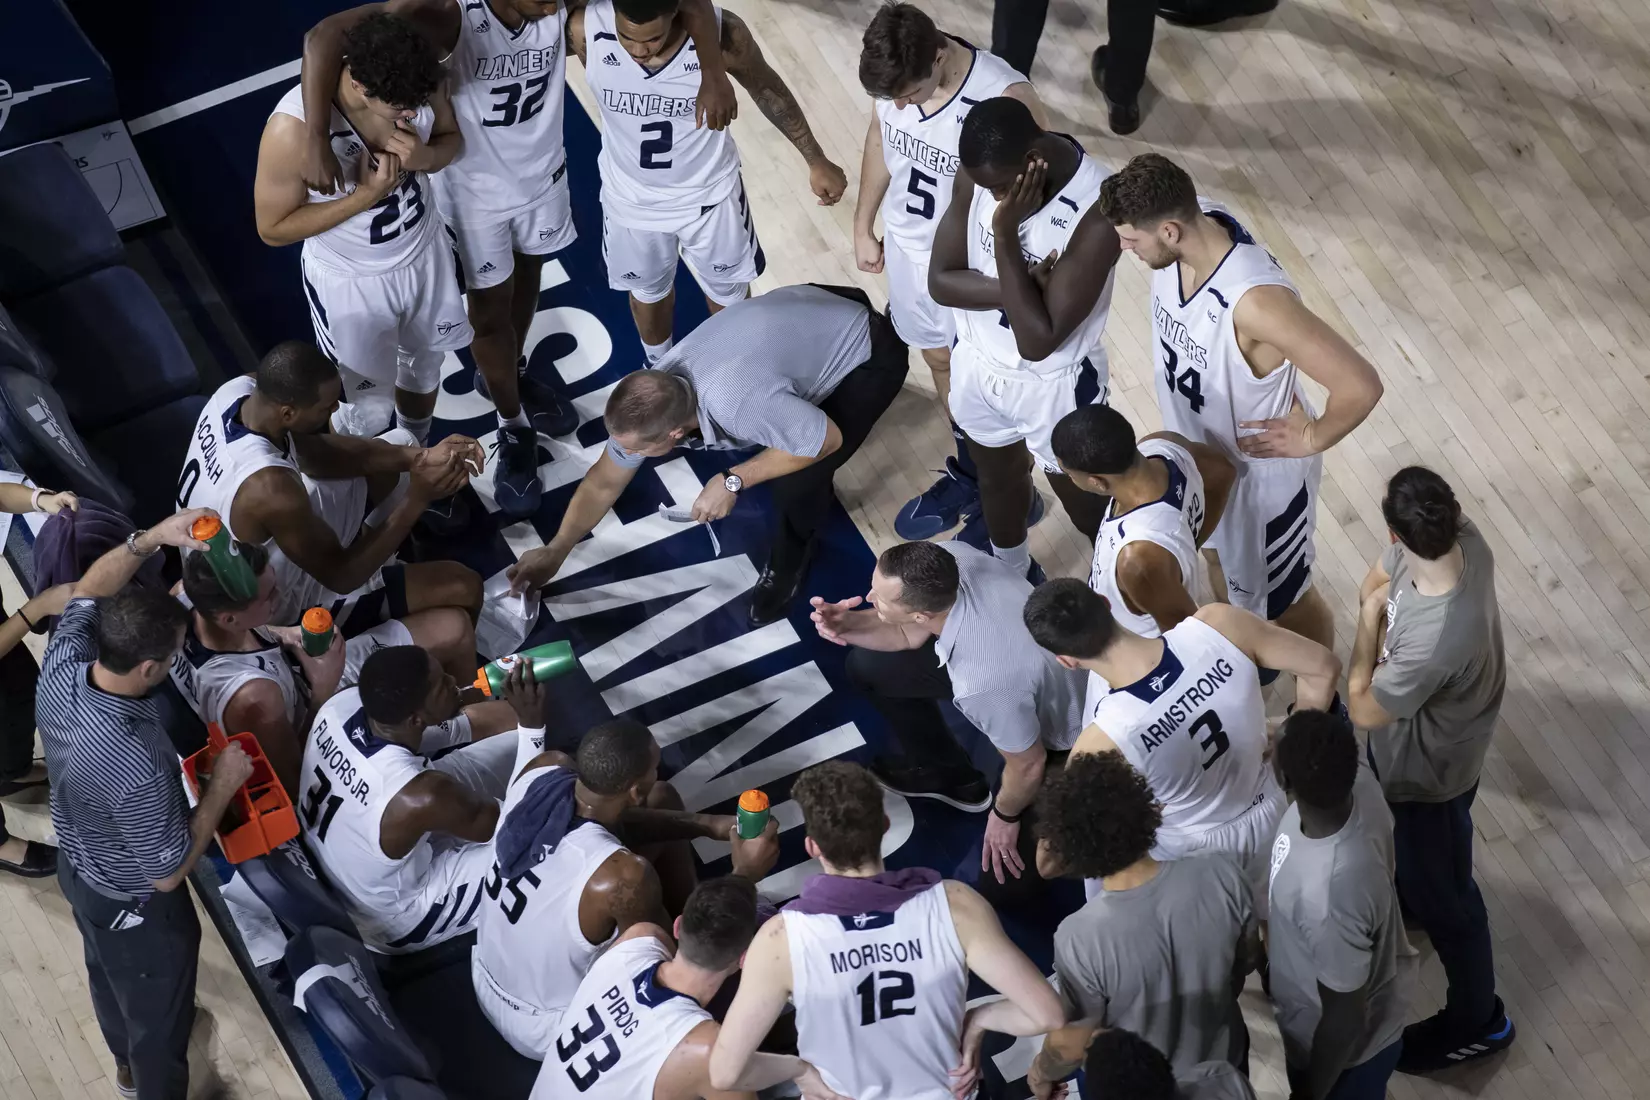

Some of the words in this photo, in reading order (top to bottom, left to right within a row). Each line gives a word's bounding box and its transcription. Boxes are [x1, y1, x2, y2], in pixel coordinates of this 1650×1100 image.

[683, 63, 700, 72] WA
[482, 71, 551, 128] 32
[603, 89, 697, 117] LANCERS
[640, 120, 673, 169] 2
[885, 121, 960, 177] LANCERS
[369, 171, 425, 245] 23
[906, 166, 937, 220] 5
[1050, 216, 1068, 230] WAC
[1160, 336, 1205, 415] 34
[176, 458, 201, 509] 0
[1140, 658, 1234, 753] ARMSTRONG
[313, 718, 357, 787] FLAVORS
[350, 778, 370, 806] JR.
[1188, 709, 1230, 771] 3
[300, 764, 344, 844] 31
[829, 938, 923, 974] MORISON
[856, 970, 917, 1026] 12
[556, 1003, 621, 1092] 33
